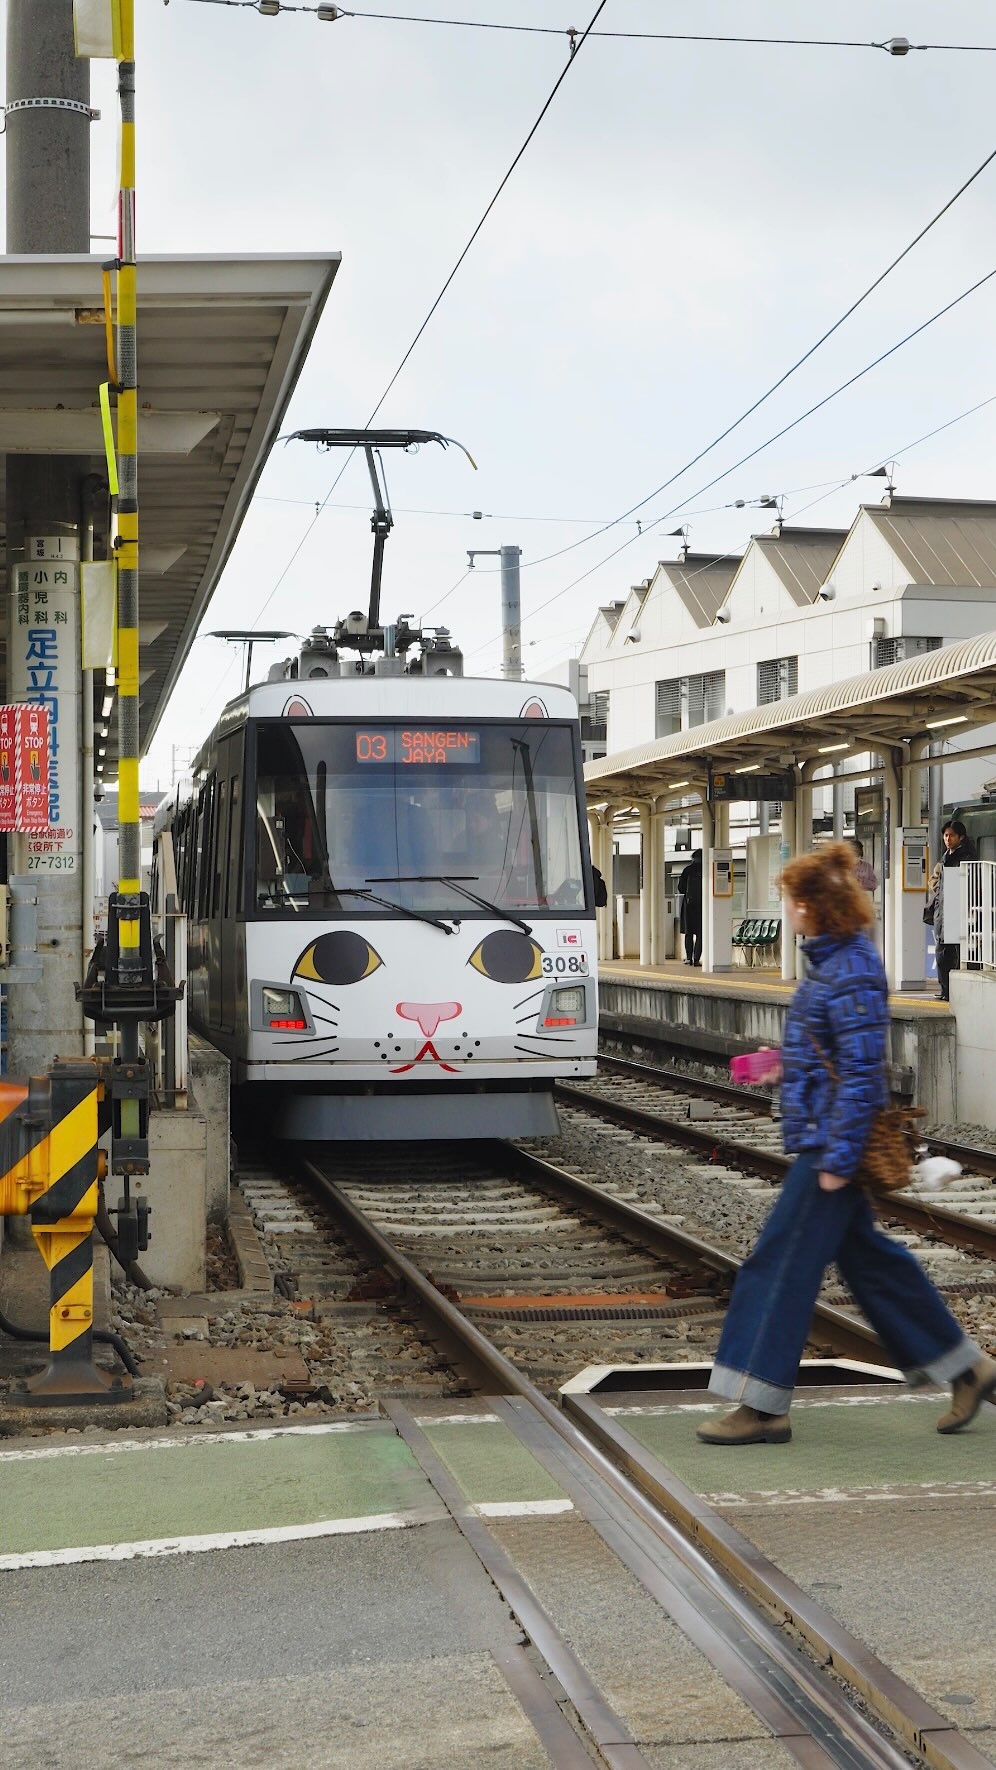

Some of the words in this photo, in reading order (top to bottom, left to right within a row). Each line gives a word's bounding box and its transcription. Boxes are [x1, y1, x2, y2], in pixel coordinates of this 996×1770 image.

[34, 570, 48, 624] 小児科
[24, 736, 44, 749] STOP
[401, 731, 477, 748] SANGEN-
[356, 735, 387, 760] 03
[401, 748, 446, 763] JAYA
[22, 783, 48, 796] 非常停止
[25, 796, 45, 808] ボタン
[28, 828, 73, 839] 谷駅前通り
[28, 856, 74, 869] 27-7312
[542, 956, 579, 973] 308
